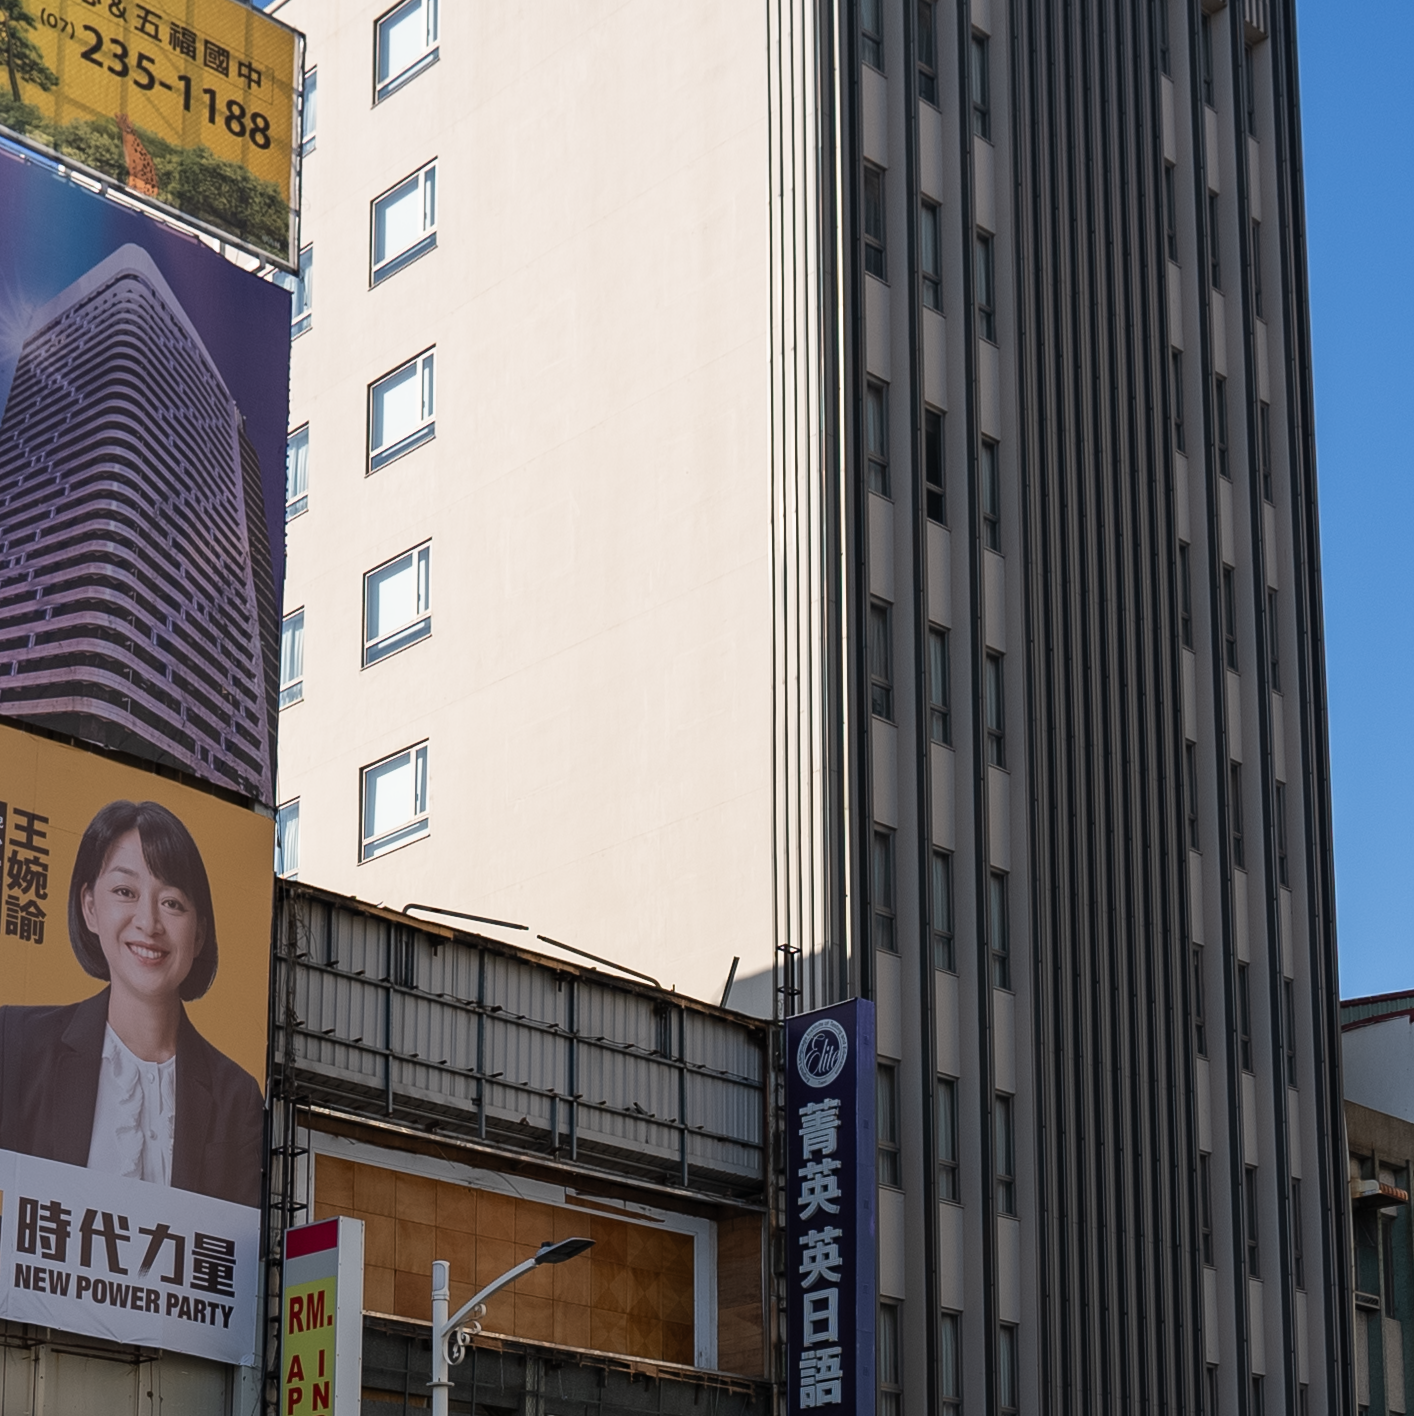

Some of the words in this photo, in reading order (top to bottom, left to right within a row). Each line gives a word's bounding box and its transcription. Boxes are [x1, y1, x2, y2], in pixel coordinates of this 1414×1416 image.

[40, 8, 75, 40] (07)
[80, 24, 272, 150] 235-1188
[4, 806, 50, 945] 王婉諭
[14, 1262, 72, 1298] NEW
[75, 1274, 161, 1314] POWER
[165, 1291, 235, 1330] PARTY
[16, 1195, 237, 1299] 時代力量
[798, 1097, 843, 1409] 菁英英日語
[288, 1289, 333, 1335] RM.
